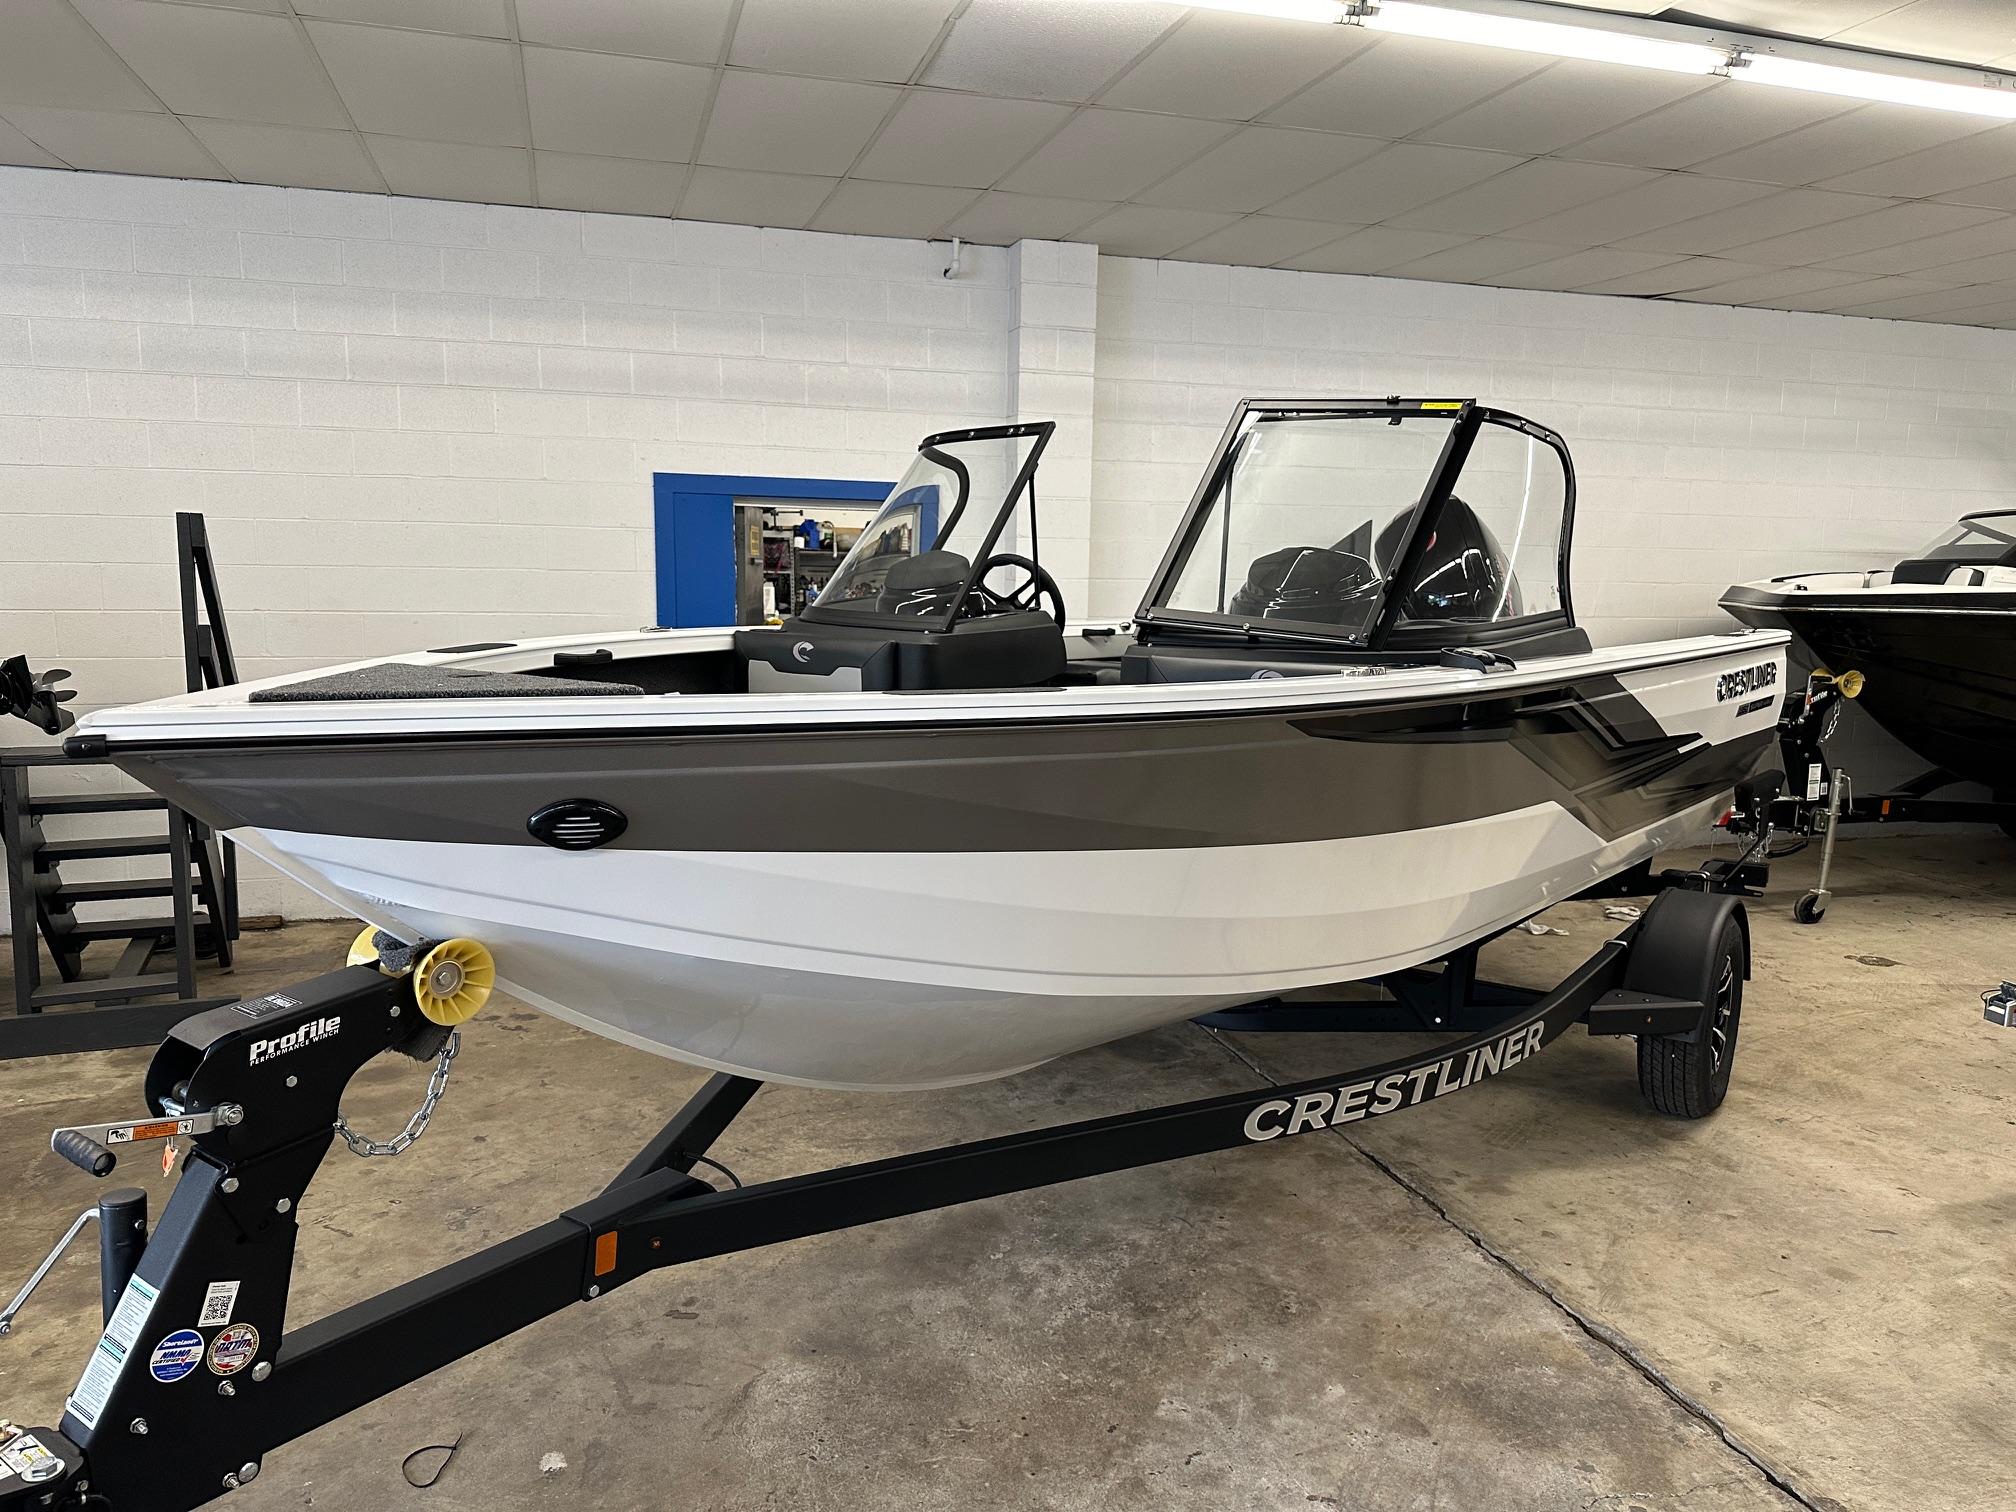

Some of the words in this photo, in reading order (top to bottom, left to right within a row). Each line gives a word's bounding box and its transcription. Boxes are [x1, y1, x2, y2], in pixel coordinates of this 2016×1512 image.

[1716, 661, 1777, 702] CRESTLINER
[250, 1016, 341, 1061] Profile
[250, 1039, 310, 1067] PERFORMANCE
[312, 1028, 339, 1043] WINCH
[1243, 1020, 1545, 1141] CRESTLINER
